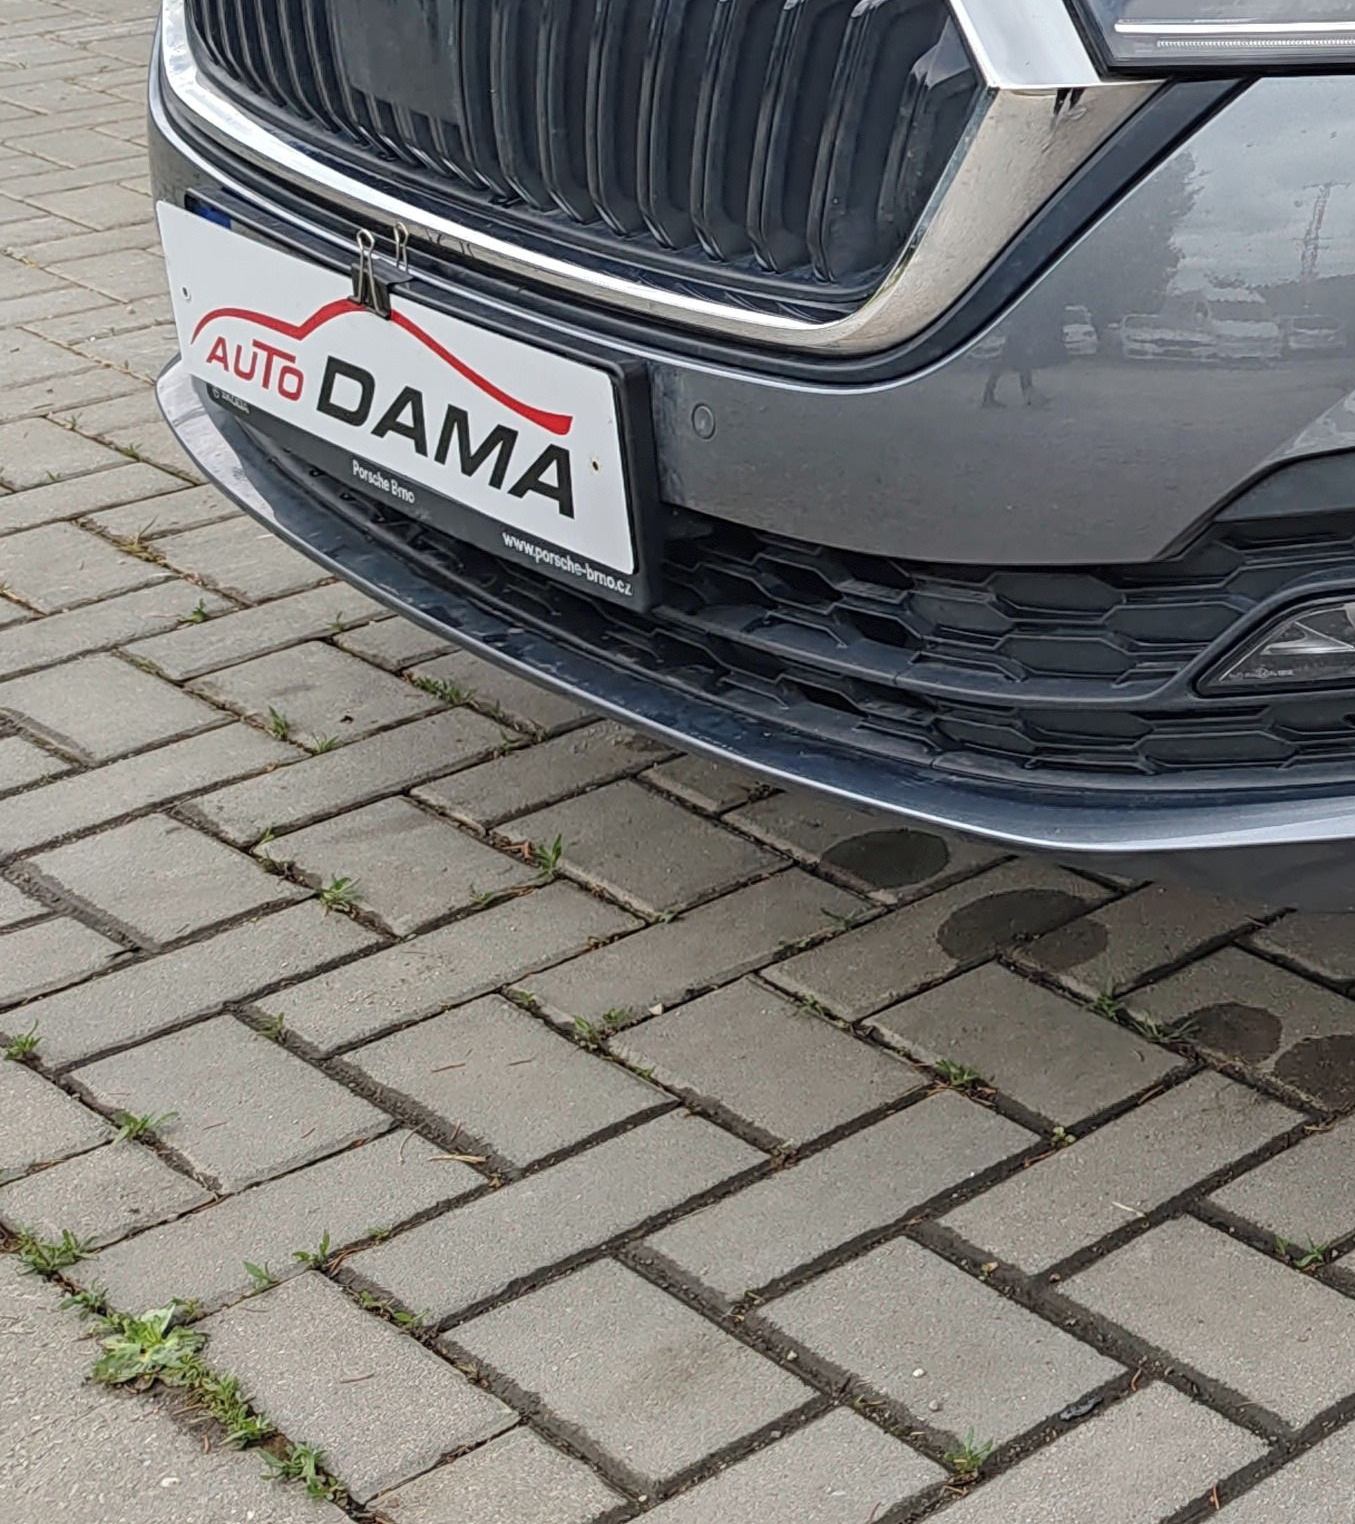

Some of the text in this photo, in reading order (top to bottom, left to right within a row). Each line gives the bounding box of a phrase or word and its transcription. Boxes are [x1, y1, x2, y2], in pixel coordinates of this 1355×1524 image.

[206, 335, 576, 520] AUTO DAMA
[352, 459, 416, 504] Porsche Brno
[502, 531, 633, 596] www.porsche-brno.cz
